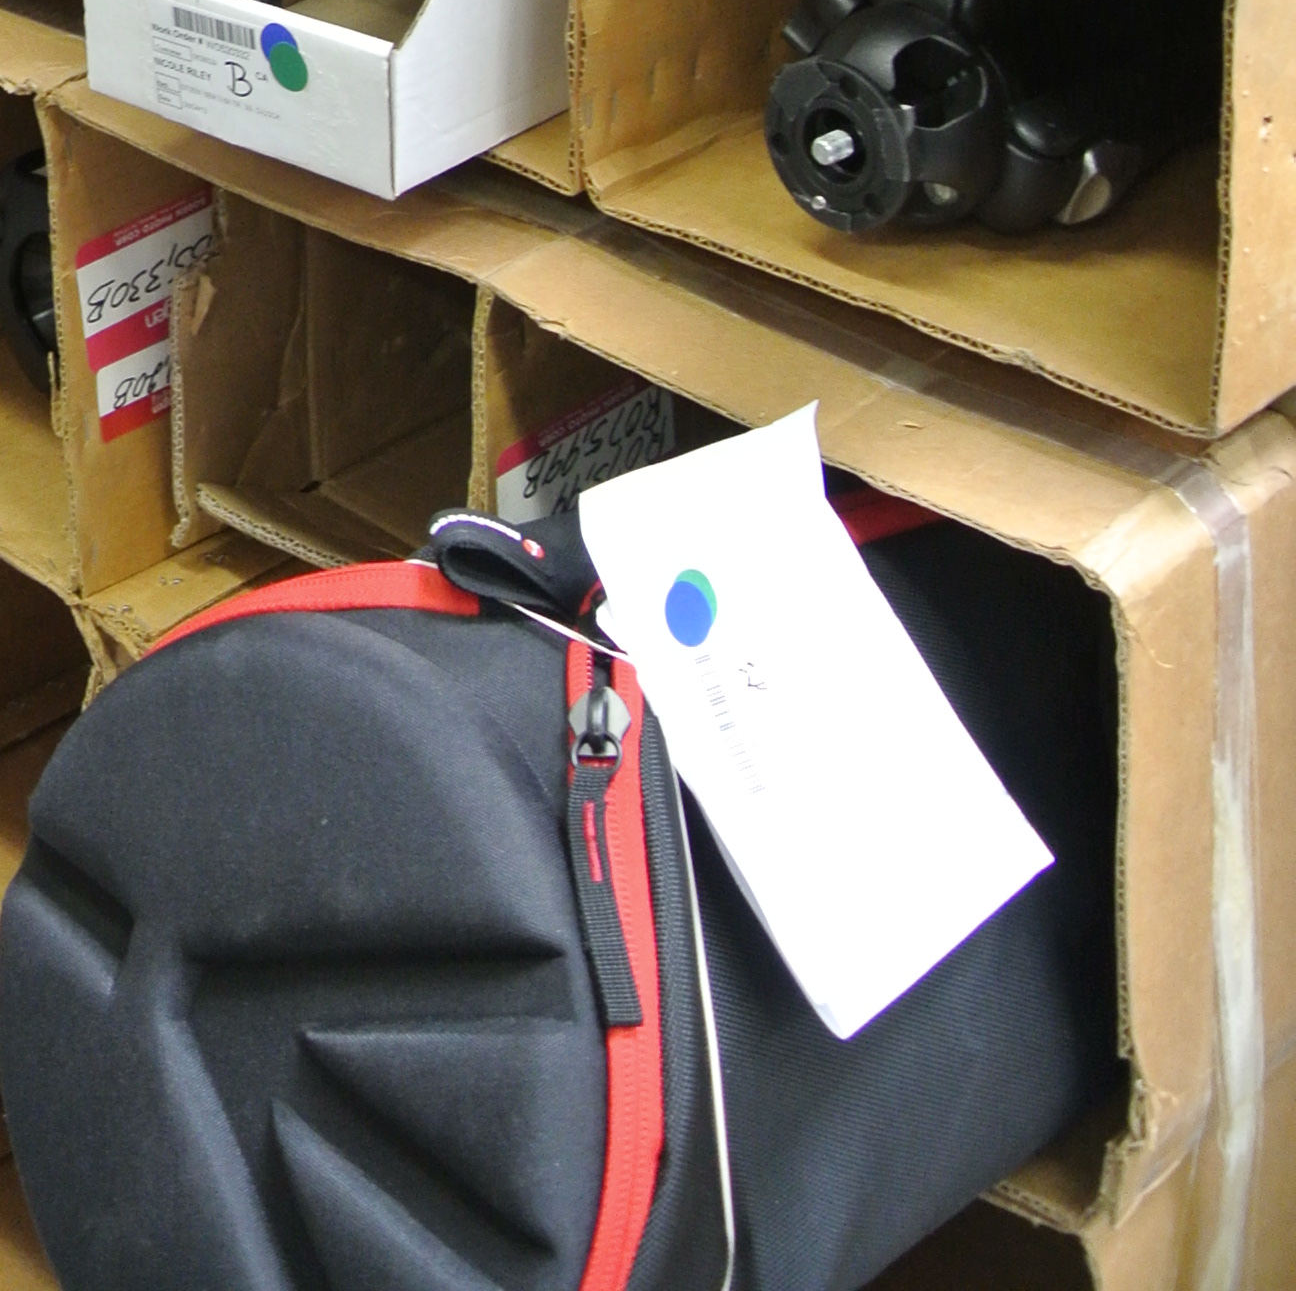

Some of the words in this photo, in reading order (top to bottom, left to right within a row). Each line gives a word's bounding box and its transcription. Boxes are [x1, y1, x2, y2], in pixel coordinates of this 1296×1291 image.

[154, 56, 185, 74] NICOLE
[186, 65, 212, 81] RILEY
[224, 60, 253, 98] B
